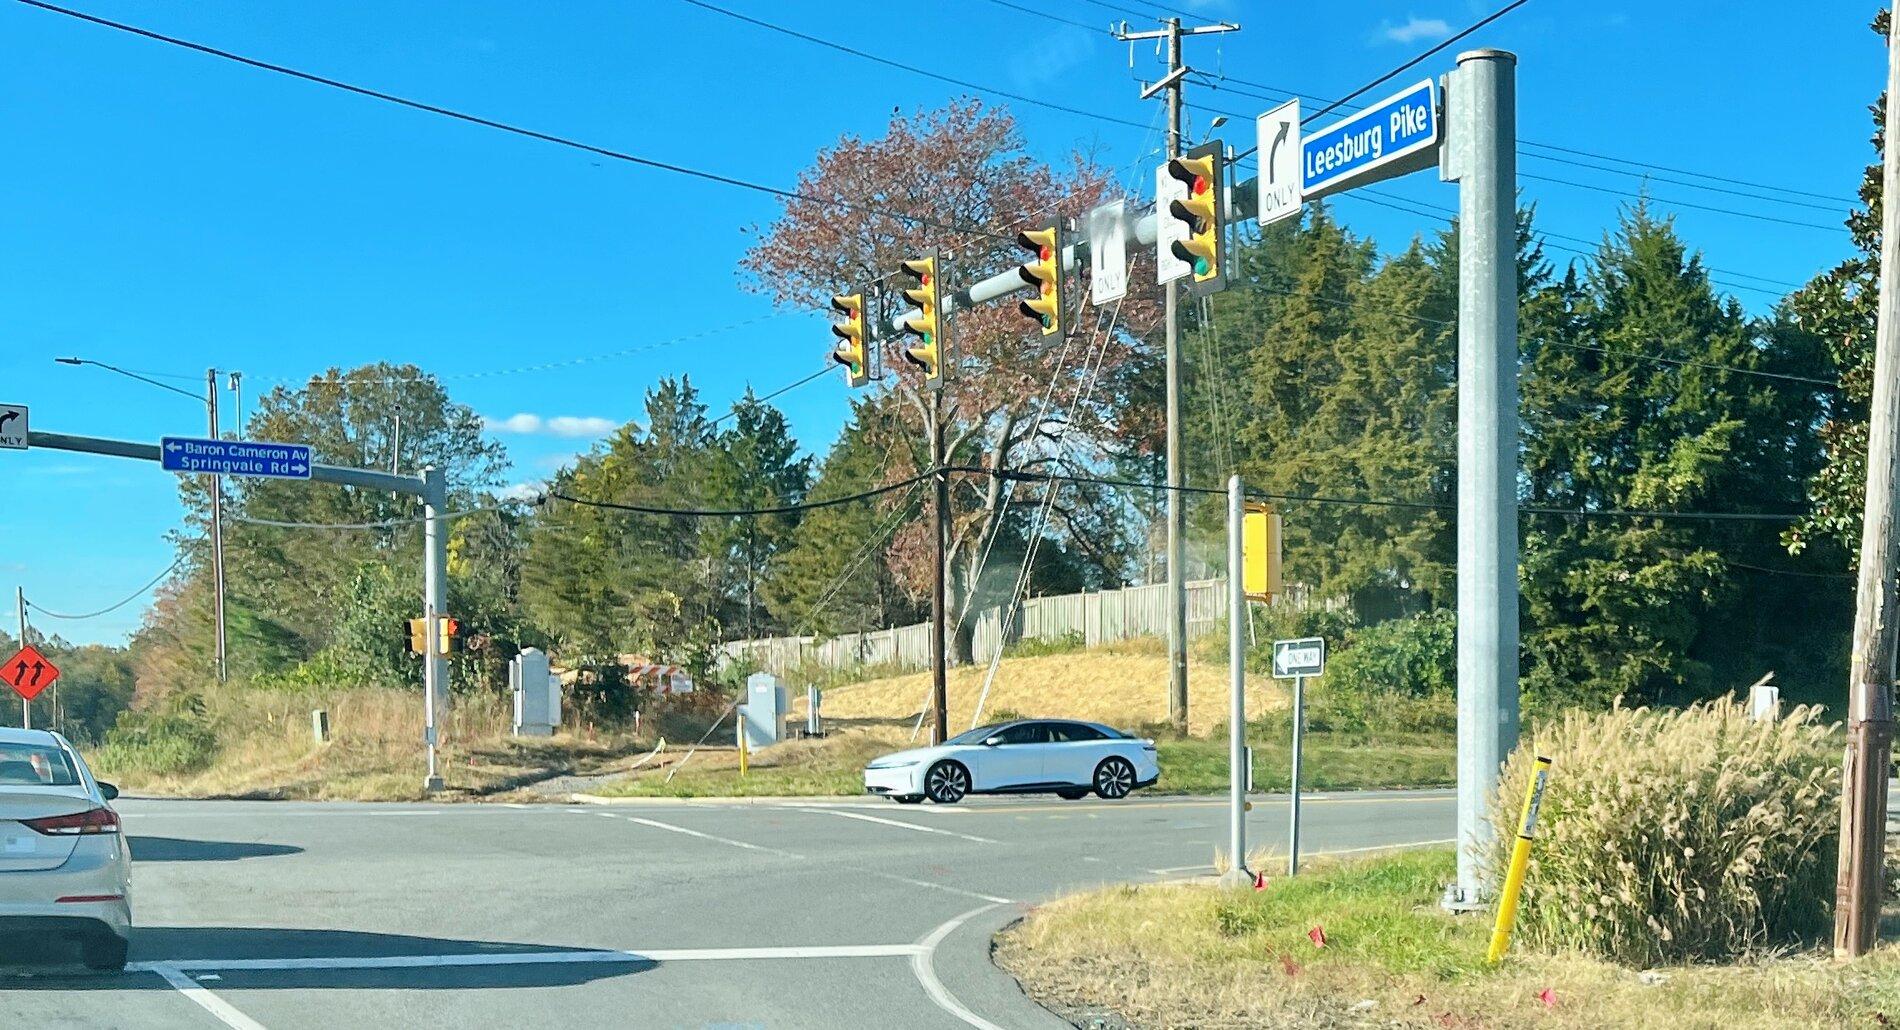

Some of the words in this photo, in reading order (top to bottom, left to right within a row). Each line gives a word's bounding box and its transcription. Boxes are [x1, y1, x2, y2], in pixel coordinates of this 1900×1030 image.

[1307, 124, 1382, 179] Leesburg
[1390, 104, 1427, 143] Pike
[1266, 183, 1295, 212] ONLY
[0, 436, 22, 446] NLY
[185, 442, 225, 456] Baron
[229, 445, 288, 460] Cameron
[292, 450, 308, 461] Av
[181, 456, 263, 472] Springvale
[271, 462, 289, 474] Rd
[1288, 652, 1301, 665] ONE
[1303, 650, 1317, 663] WAY
